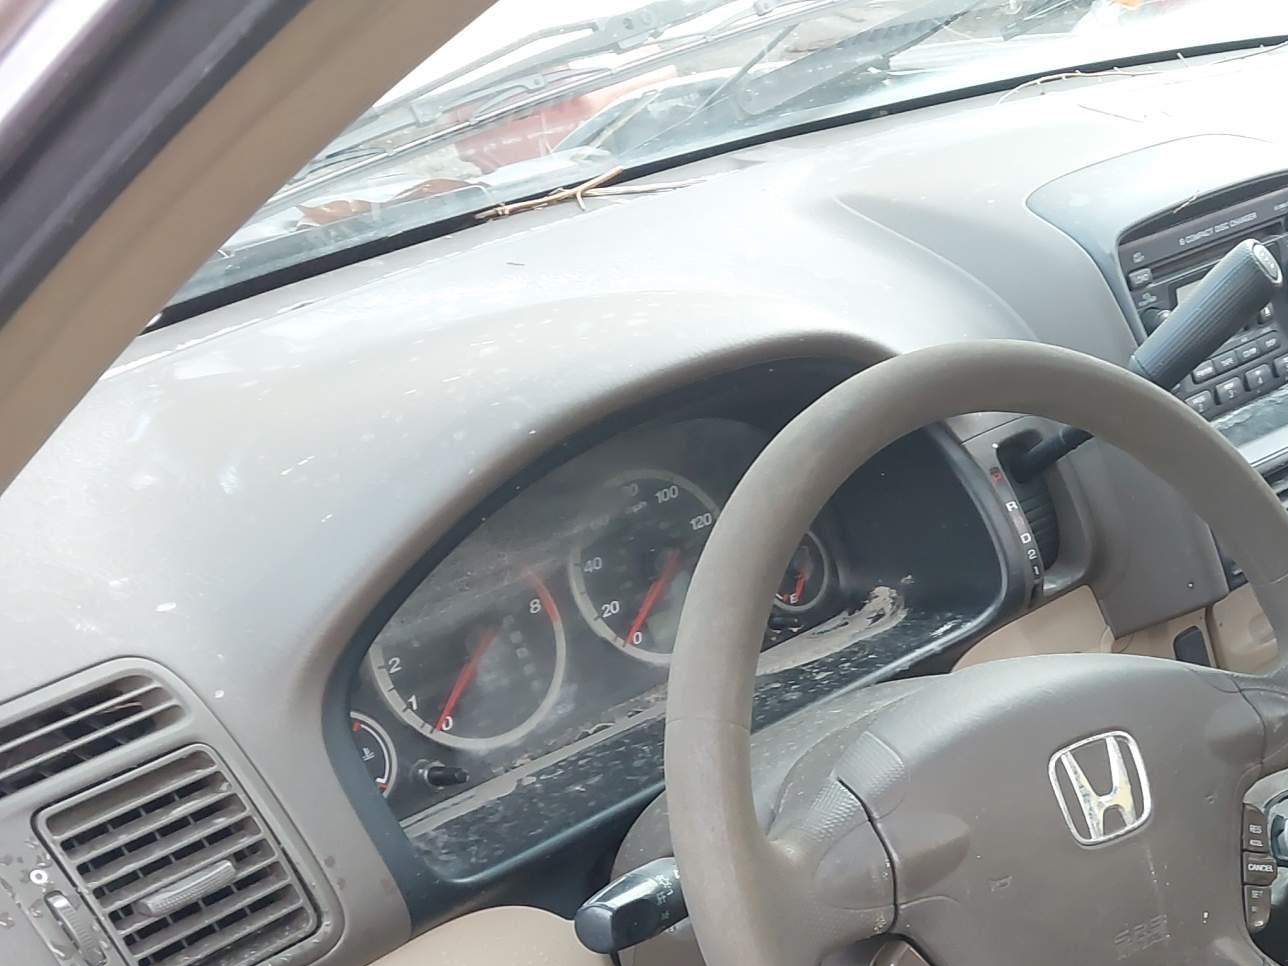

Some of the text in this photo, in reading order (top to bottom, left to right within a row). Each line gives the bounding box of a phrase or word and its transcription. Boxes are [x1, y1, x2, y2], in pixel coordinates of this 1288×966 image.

[1185, 227, 1214, 244] COMPACT
[1230, 211, 1257, 228] CHANGER
[655, 485, 679, 504] 100
[1005, 501, 1018, 512] R
[690, 512, 713, 531] 120
[1020, 532, 1032, 544] D
[1027, 549, 1038, 560] 2
[583, 557, 603, 574] 40
[1033, 566, 1040, 576] 1
[528, 599, 542, 614] 8
[601, 600, 621, 618] 20
[632, 630, 643, 645] 0
[388, 656, 401, 674] 2
[406, 695, 418, 711] 1
[441, 715, 453, 731] 0
[1249, 824, 1263, 834] RES
[1247, 863, 1274, 873] CANCEL
